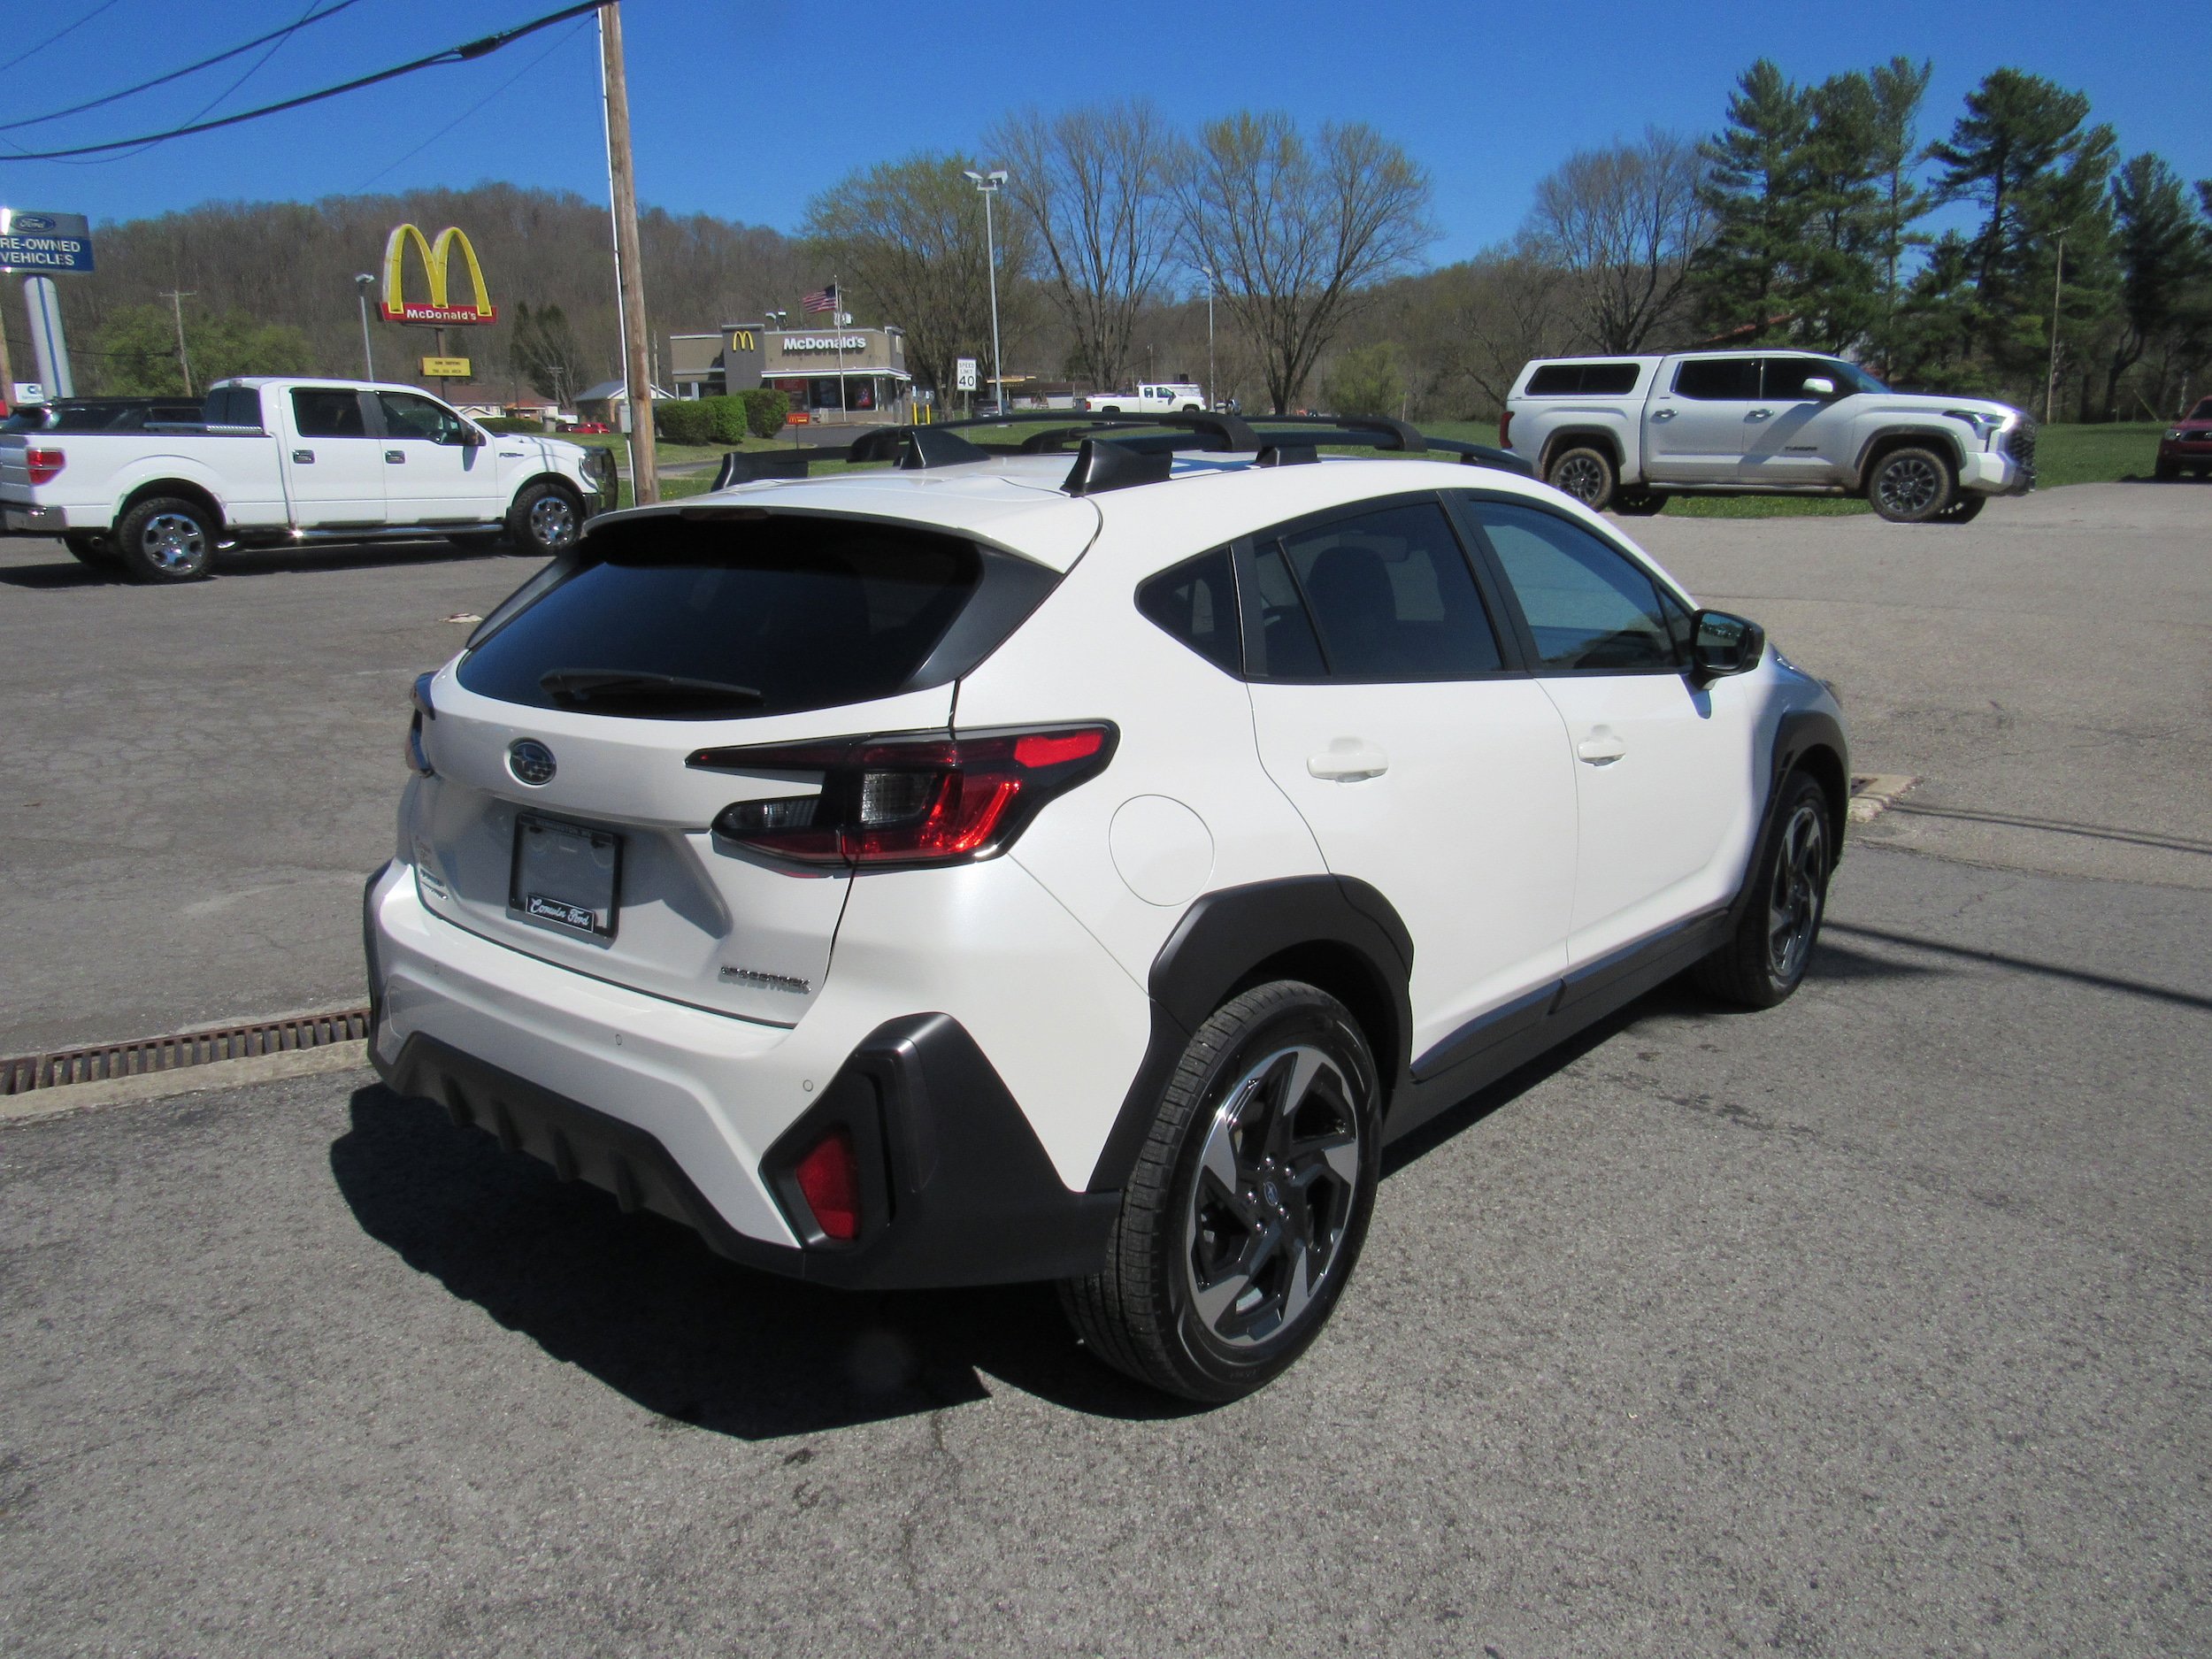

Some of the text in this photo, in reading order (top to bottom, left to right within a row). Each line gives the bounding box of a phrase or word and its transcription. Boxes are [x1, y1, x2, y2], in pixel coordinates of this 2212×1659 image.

[19, 218, 45, 228] Ford
[0, 251, 75, 266] VEHICLES
[407, 309, 477, 320] McDonald's
[784, 336, 866, 350] McDonald's
[959, 375, 975, 387] 40
[567, 908, 590, 926] Ford
